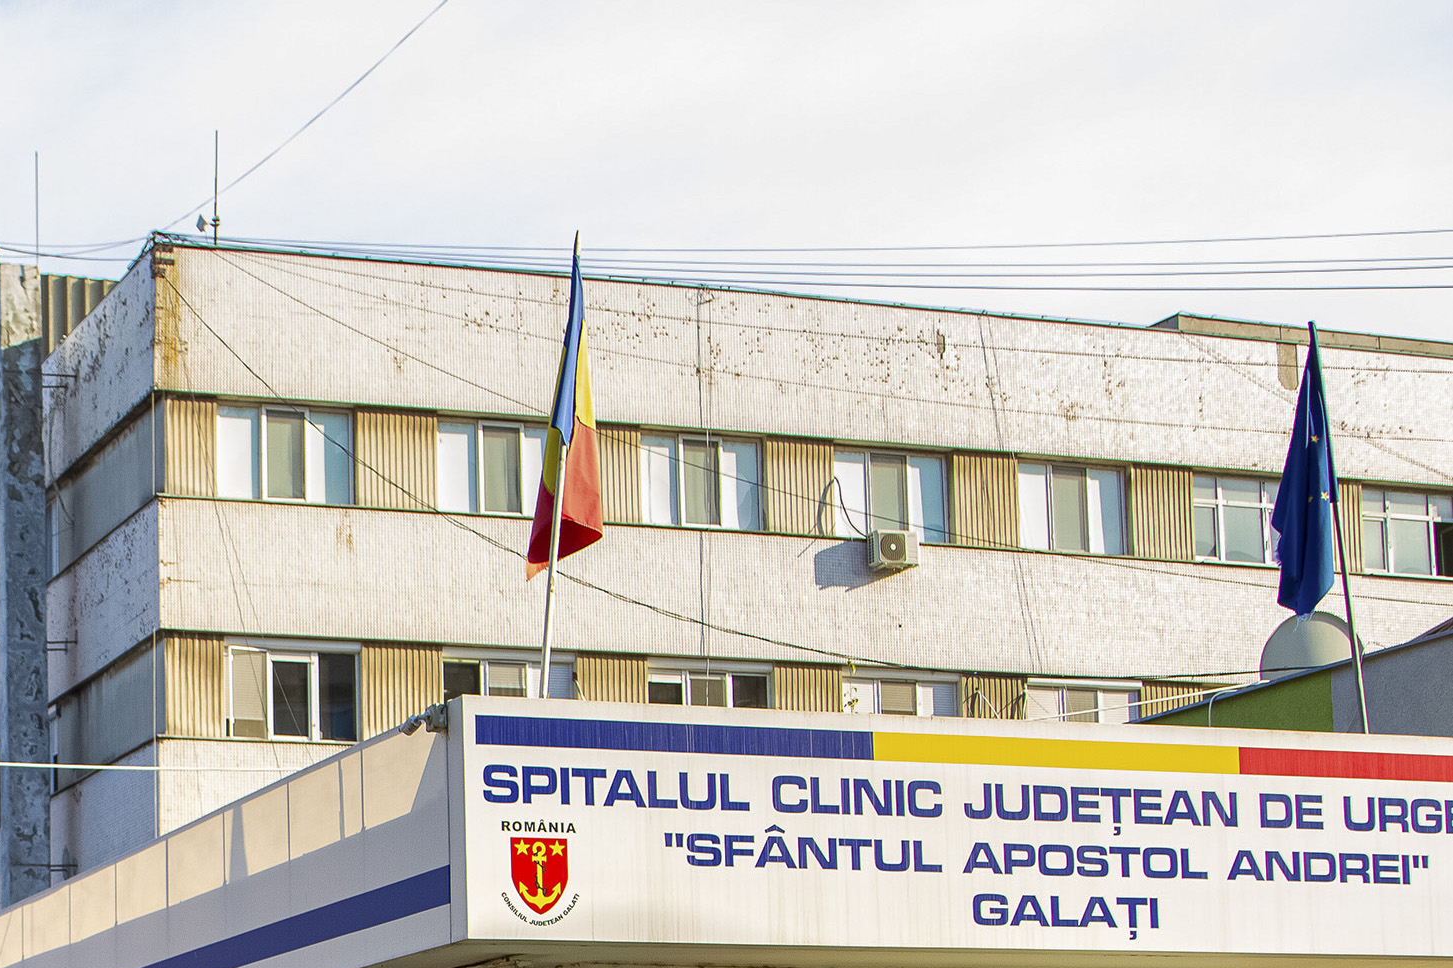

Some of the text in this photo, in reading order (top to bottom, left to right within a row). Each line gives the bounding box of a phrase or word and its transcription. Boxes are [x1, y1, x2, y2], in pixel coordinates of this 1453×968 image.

[483, 763, 1453, 836] SPITALUL CLINIC JUDEȚEAN DE URG
[501, 819, 576, 834] ROMÂNIA
[664, 823, 1429, 885] "SFÂNTUL APOSTOL ANDREI"
[501, 892, 528, 923] CONSILIUL
[973, 893, 1160, 941] GALAȚI
